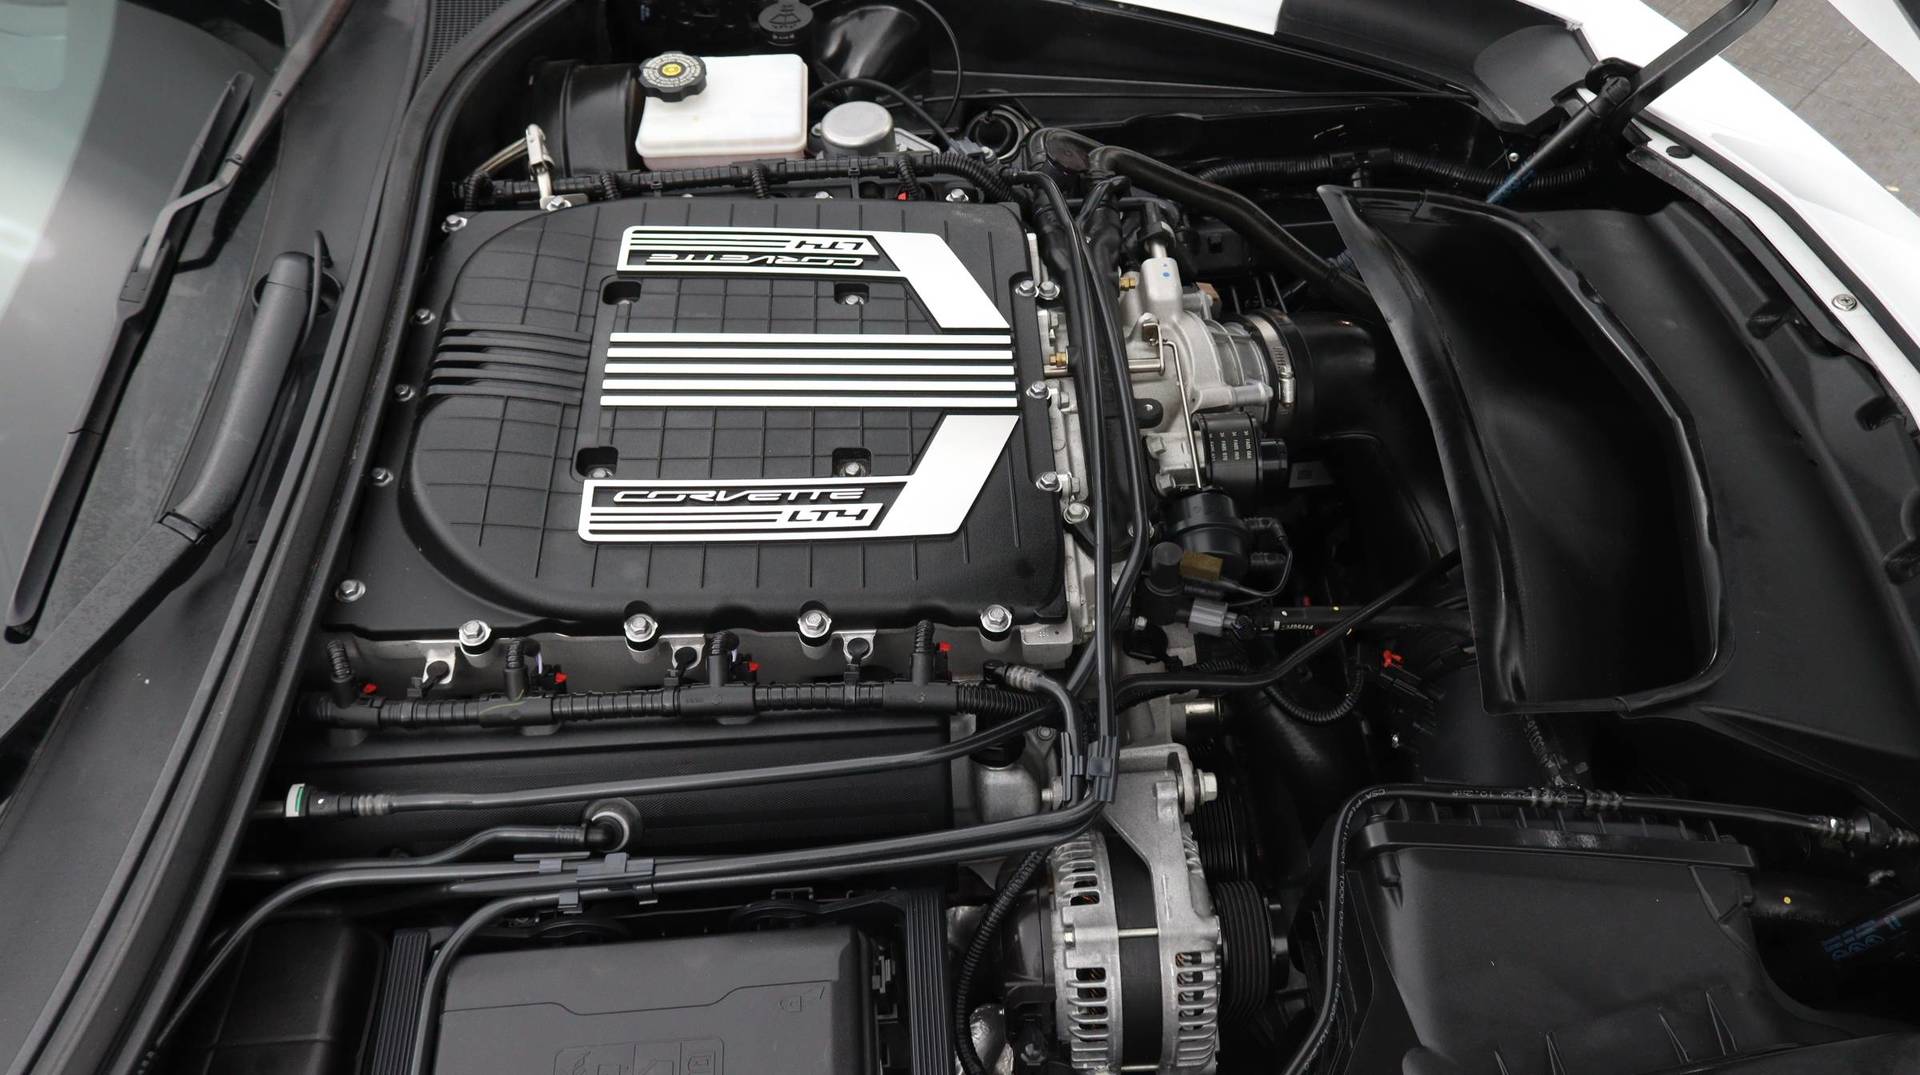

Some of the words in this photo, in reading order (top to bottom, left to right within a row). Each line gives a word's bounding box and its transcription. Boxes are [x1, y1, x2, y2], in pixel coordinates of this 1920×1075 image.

[795, 240, 865, 251] LT4
[646, 253, 864, 267] CORVETTE
[613, 488, 865, 503] CORVETTE
[788, 508, 869, 523] LT4
